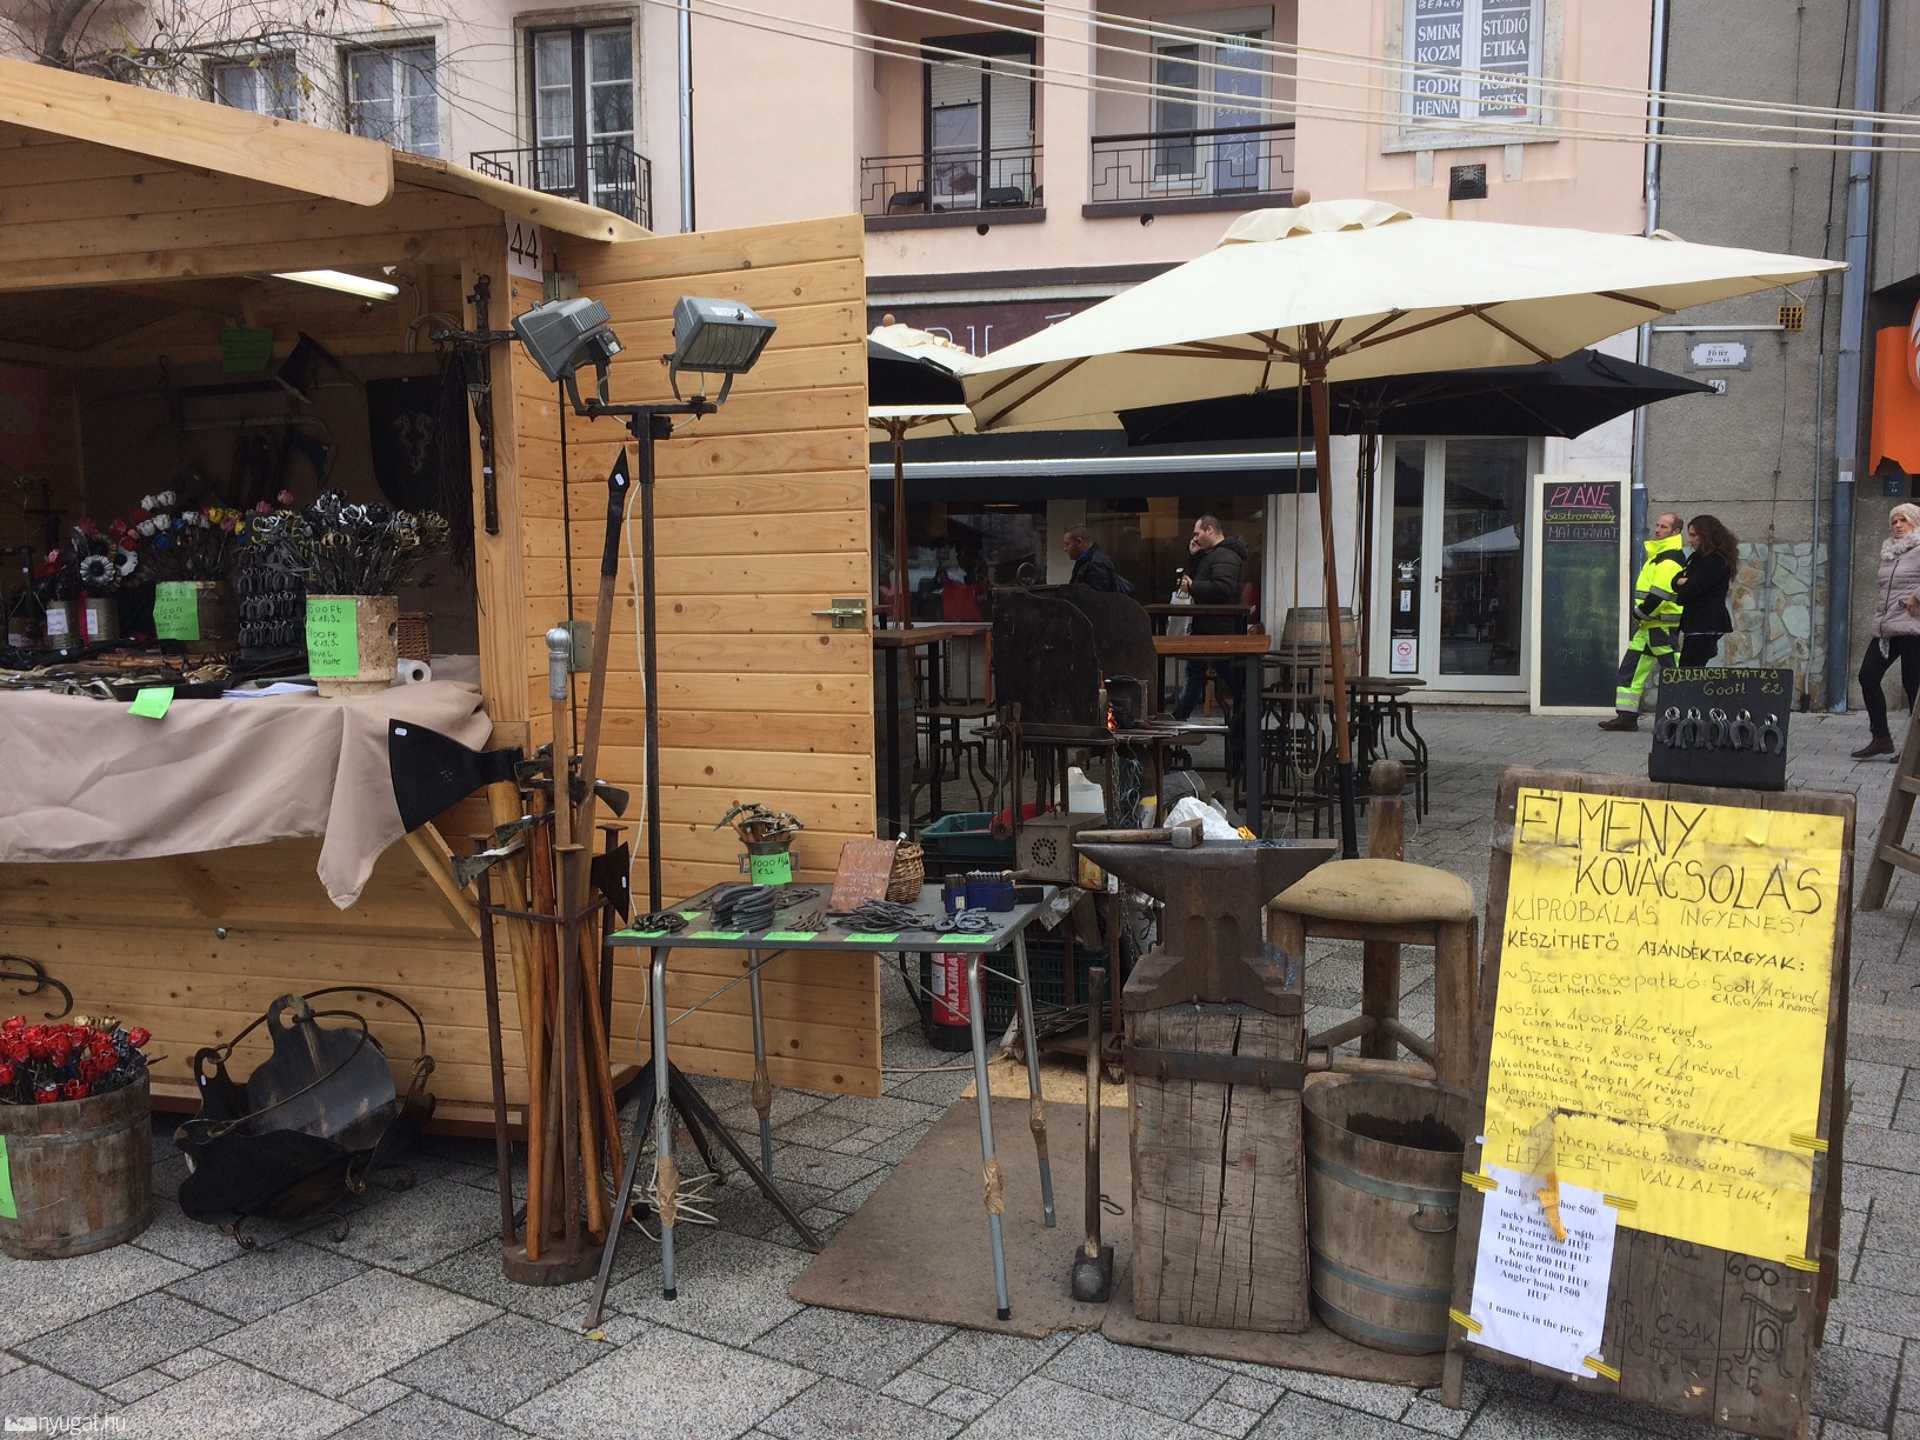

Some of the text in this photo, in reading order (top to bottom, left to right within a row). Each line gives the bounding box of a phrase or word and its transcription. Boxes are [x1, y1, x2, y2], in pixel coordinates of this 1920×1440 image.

[1418, 12, 1528, 42] SMINK STÚDIÓ
[1417, 39, 1526, 63] KOZM ETIKA
[1416, 78, 1459, 95] FODR
[1415, 99, 1458, 117] HENNA
[510, 223, 538, 269] 44
[1575, 853, 1822, 914] KOVÁCSOLÁS
[1507, 925, 1620, 951] KÉSZÍTHETŐ
[1500, 1208, 1523, 1222] lucky
[1497, 1231, 1516, 1244] Iron
[1519, 1237, 1543, 1251] heart
[1546, 1245, 1567, 1257] 1000
[1569, 1251, 1593, 1264] HUF
[1568, 1238, 1591, 1251] HUF
[1508, 1247, 1534, 1261] Knife
[1554, 1259, 1577, 1272] HUF
[1501, 1269, 1580, 1298] Angler hook 1500
[1543, 1268, 1566, 1281] 1000
[1567, 1275, 1591, 1288] HUF
[1527, 1288, 1550, 1301] HUF
[1496, 1304, 1521, 1319] name
[1543, 1318, 1558, 1330] the
[1560, 1324, 1585, 1337] price
